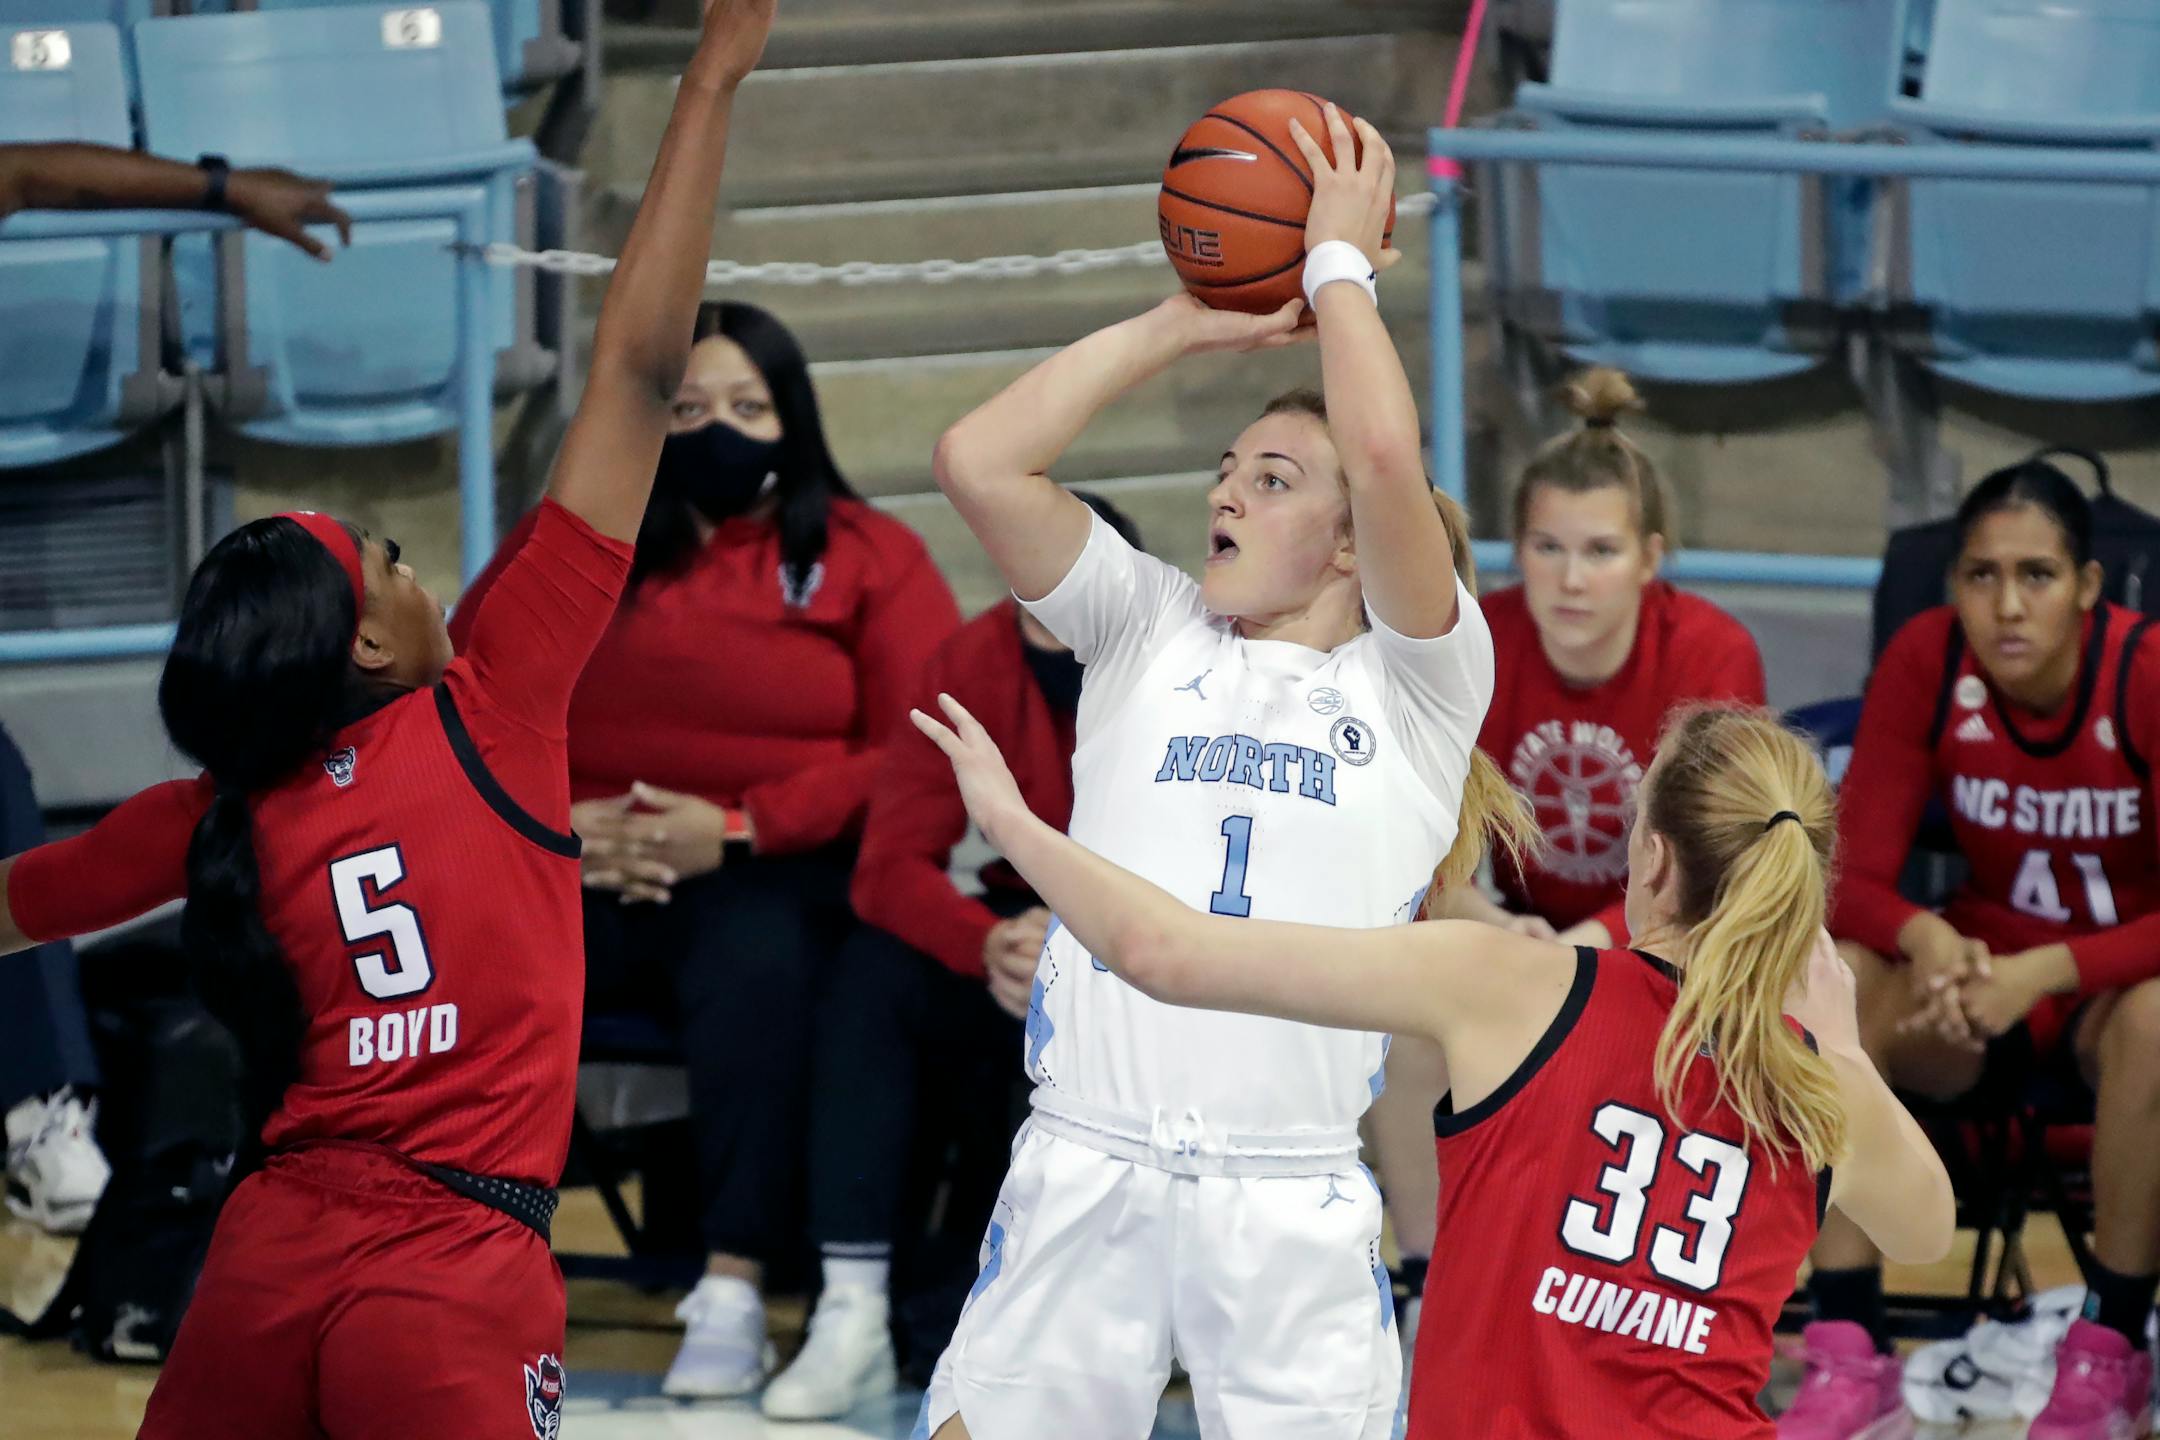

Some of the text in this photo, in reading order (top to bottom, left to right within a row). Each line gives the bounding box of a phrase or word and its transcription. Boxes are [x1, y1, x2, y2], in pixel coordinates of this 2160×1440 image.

[1160, 214, 1223, 260] ELITE
[1155, 734, 1337, 806] NORTH
[1953, 774, 2141, 838] NC STATE
[1210, 815, 1253, 918] 1
[2010, 849, 2118, 925] 41
[329, 842, 436, 999] 5
[349, 1003, 458, 1066] BOYD
[1558, 1099, 1751, 1294] 33
[1531, 1266, 1717, 1354] CUNANE
